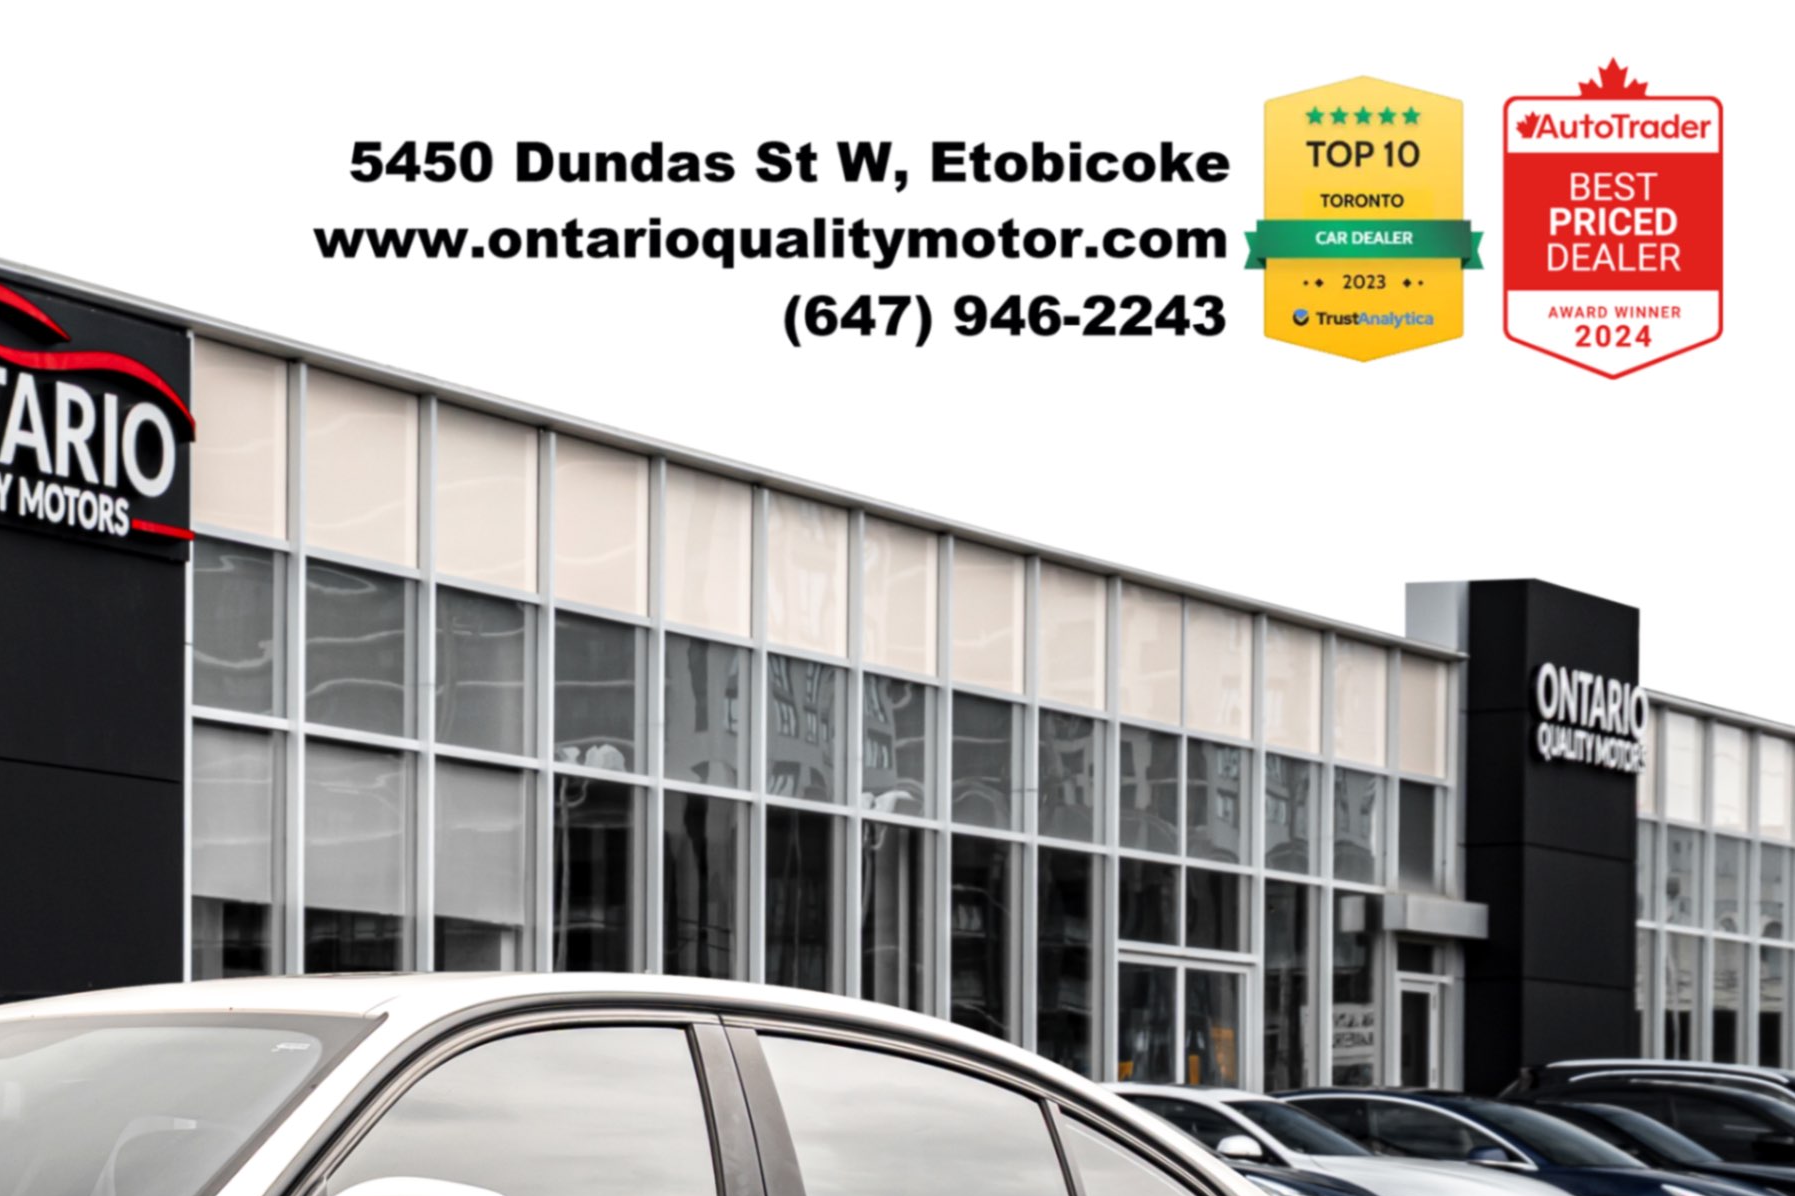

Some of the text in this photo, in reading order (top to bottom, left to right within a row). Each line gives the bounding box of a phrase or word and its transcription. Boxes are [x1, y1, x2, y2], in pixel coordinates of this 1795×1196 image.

[19, 477, 131, 537] MOTORS
[1537, 662, 1649, 739] ONTARIO
[1537, 722, 1595, 762] QUALITY
